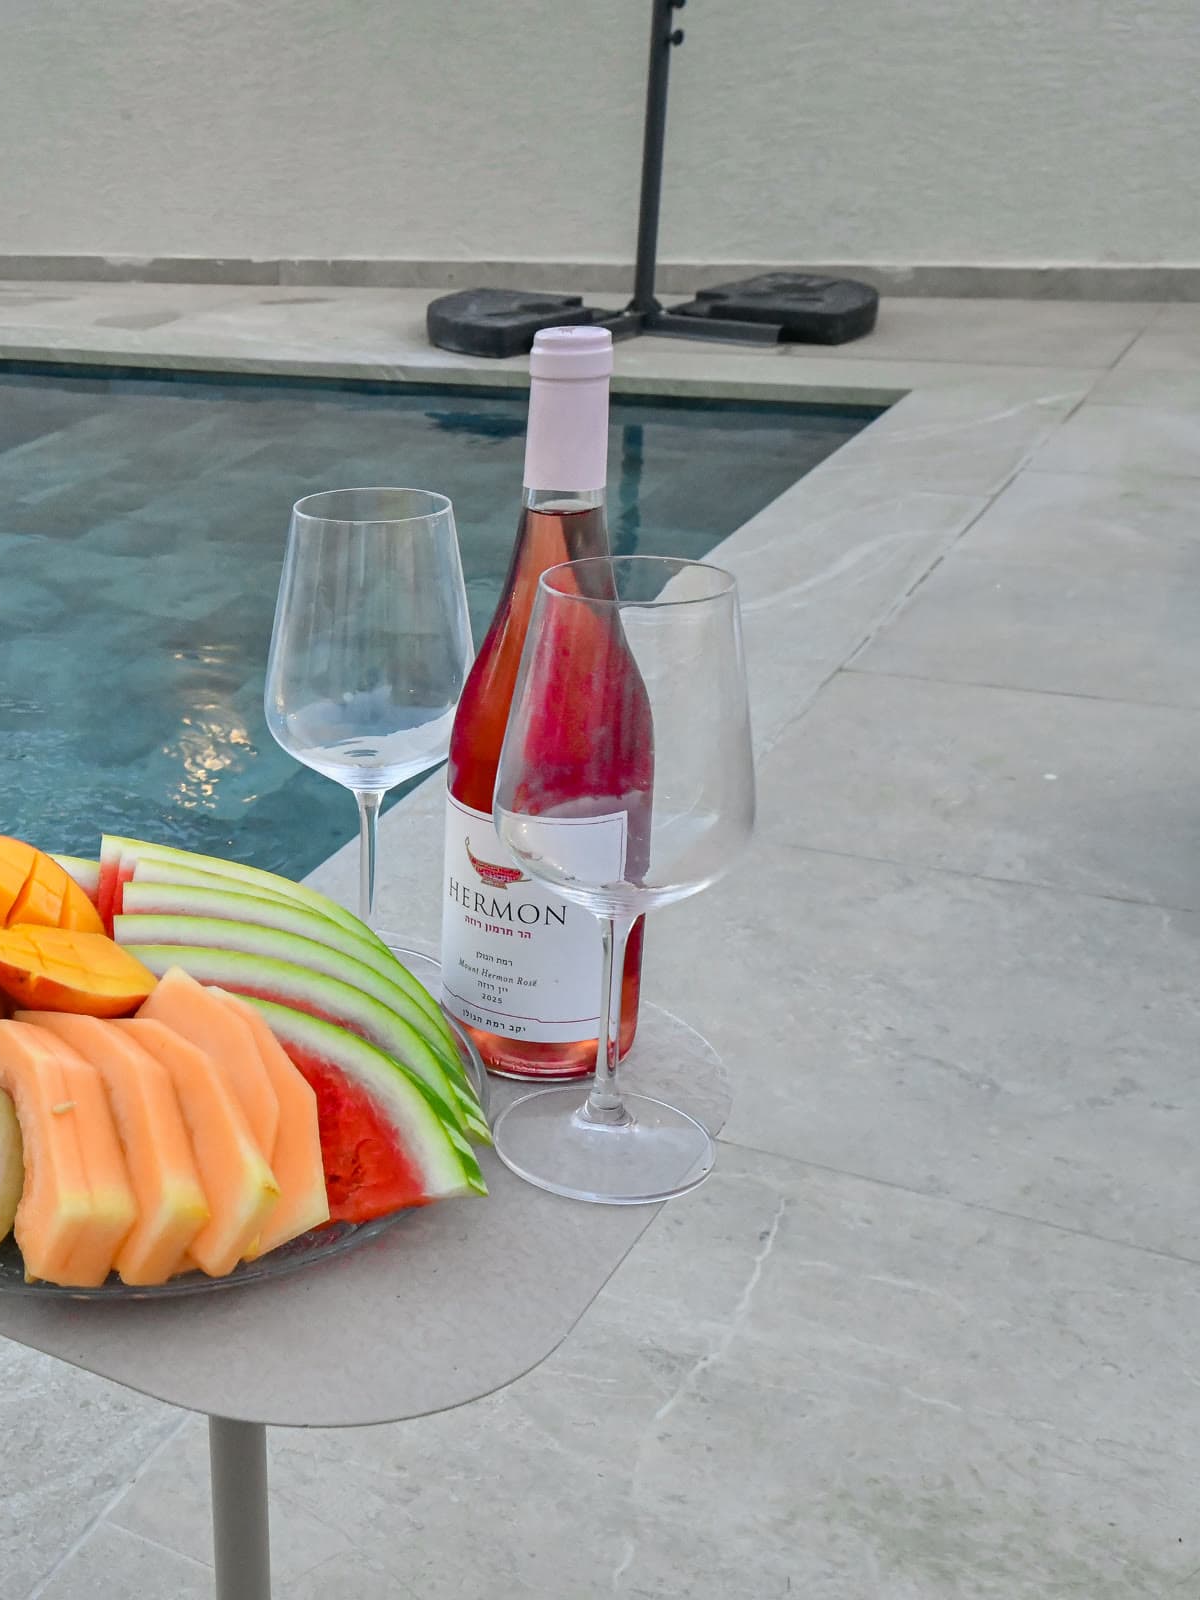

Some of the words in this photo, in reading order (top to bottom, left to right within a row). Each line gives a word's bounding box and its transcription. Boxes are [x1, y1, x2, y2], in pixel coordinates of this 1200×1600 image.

[449, 876, 568, 926] HERMON
[464, 914, 483, 929] רוזה
[517, 929, 532, 940] הר
[481, 968, 514, 984] Hermon
[481, 992, 503, 1004] 2025
[485, 1018, 505, 1030] רמת
[508, 1024, 526, 1034] יקב
